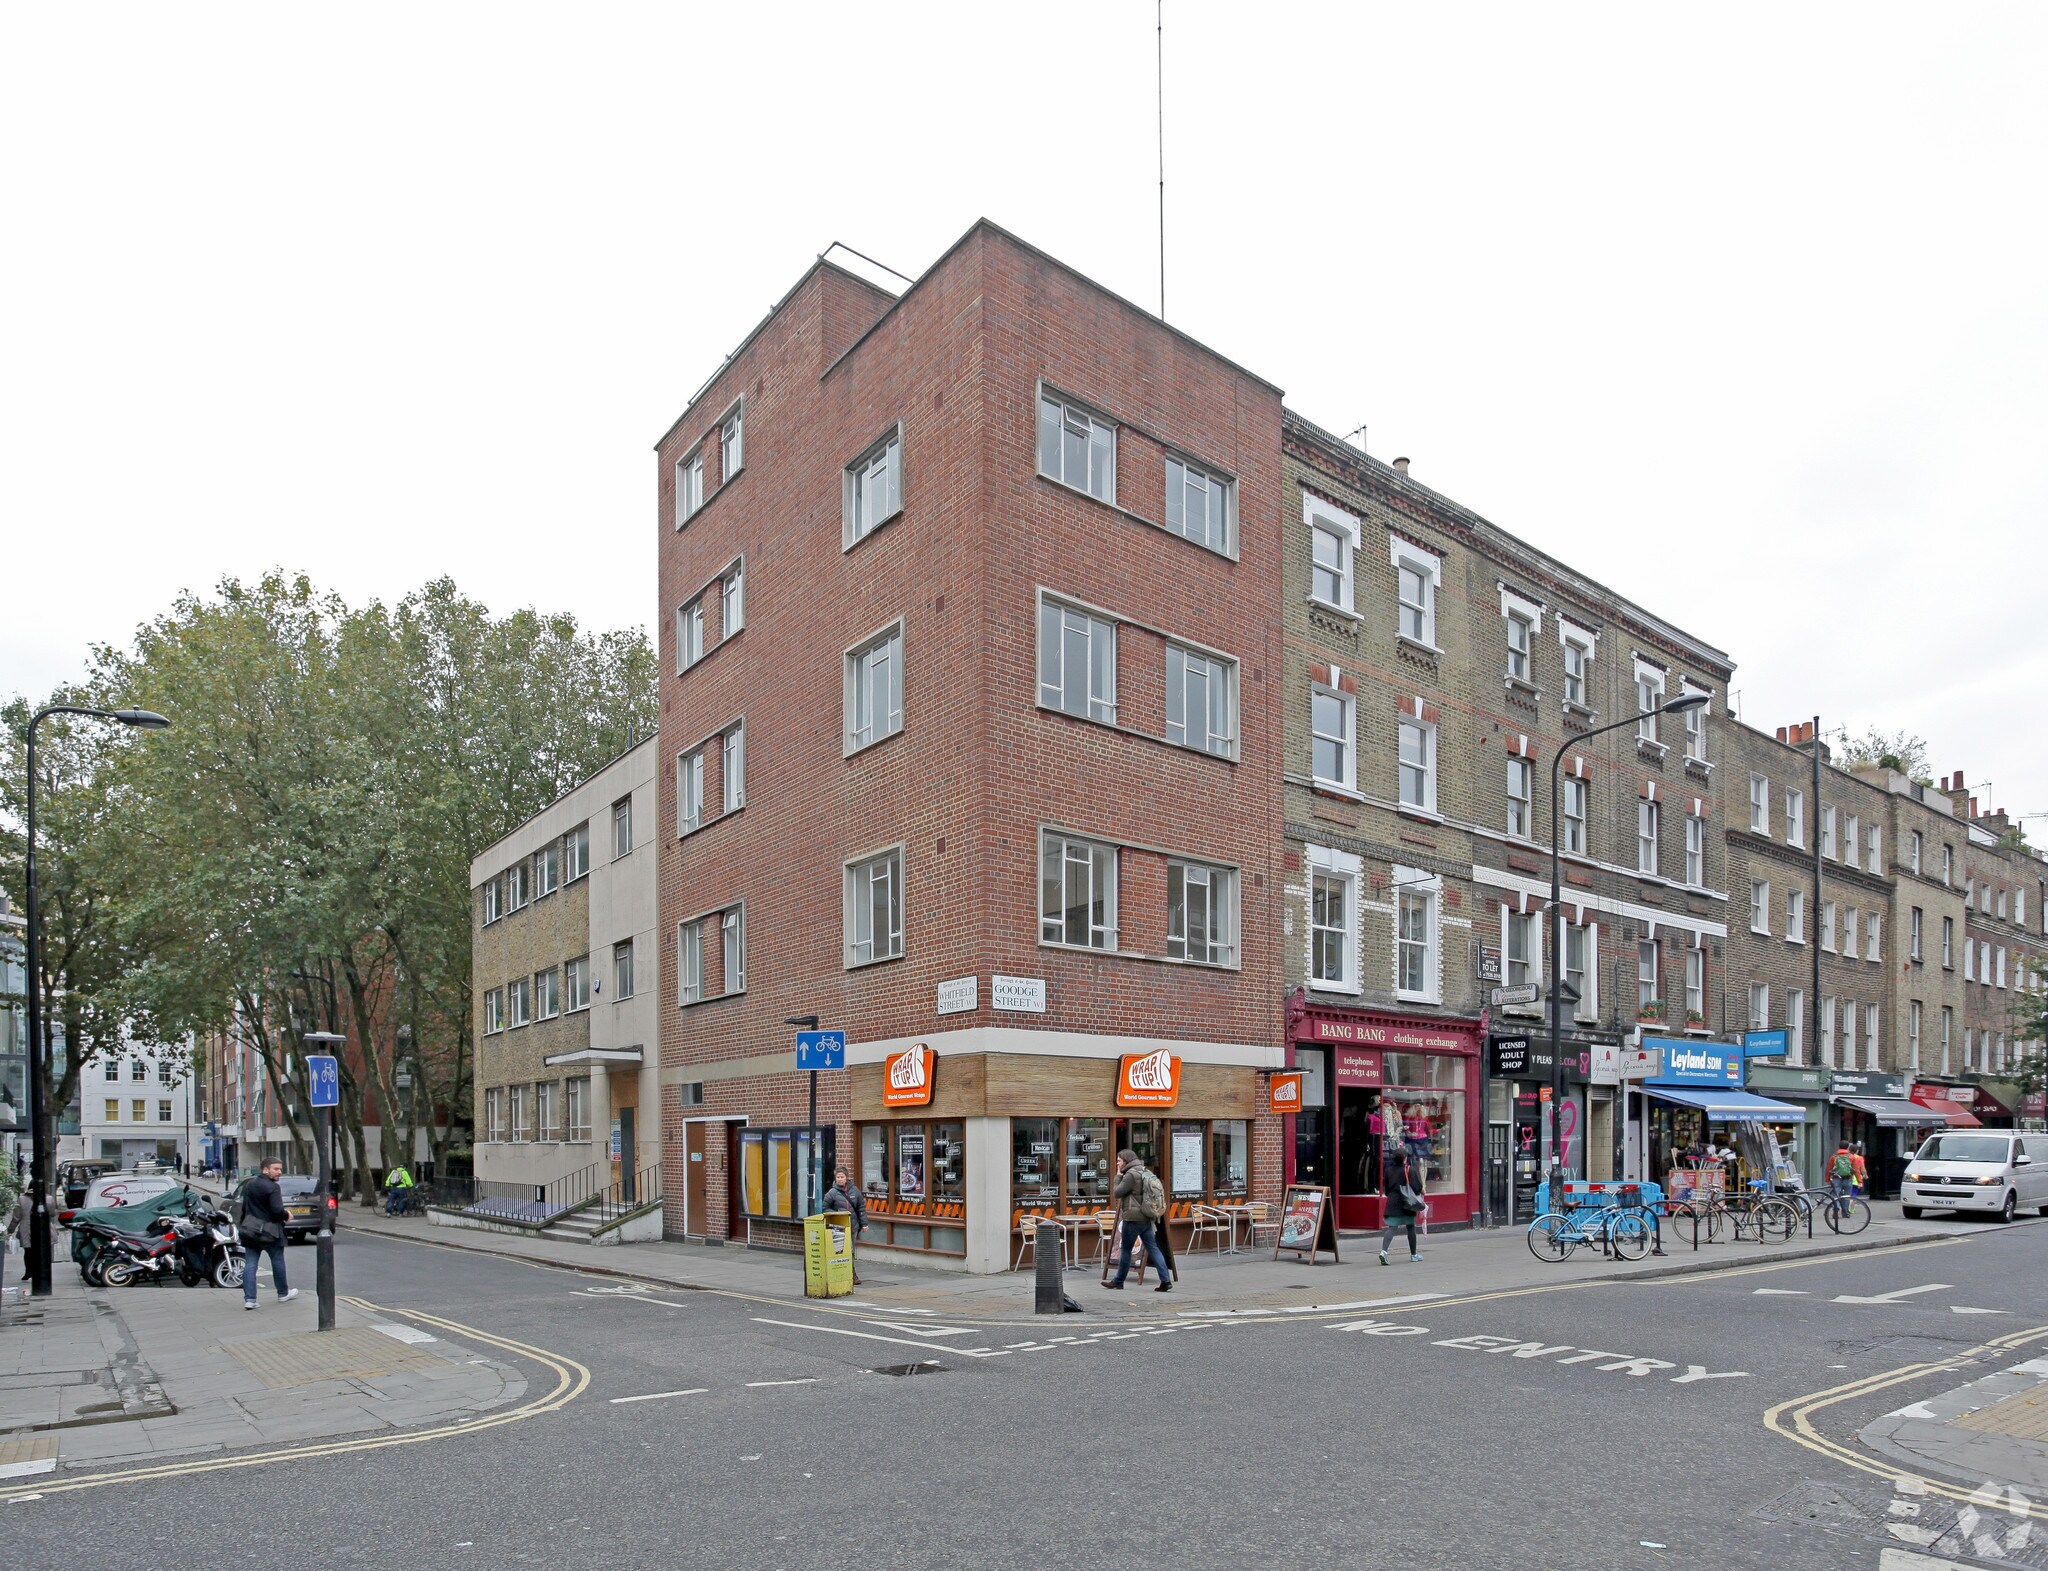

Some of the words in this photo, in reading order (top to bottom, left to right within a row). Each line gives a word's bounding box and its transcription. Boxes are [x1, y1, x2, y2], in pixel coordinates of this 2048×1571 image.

[1490, 964, 1498, 972] LET
[939, 987, 975, 1000] WHITFIELD
[994, 984, 1038, 997] GOODGE
[939, 1000, 965, 1012] STREET
[994, 996, 1032, 1008] STREET
[1321, 1023, 1352, 1039] BANG
[1357, 1027, 1386, 1042] BANG
[1394, 1033, 1424, 1048] clothing
[1426, 1036, 1458, 1050] exchange
[1498, 1041, 1526, 1050] LICENSED
[1344, 1056, 1374, 1066] telephone
[1500, 1052, 1524, 1060] ADULT
[1671, 1048, 1706, 1072] Leyland
[1706, 1056, 1722, 1070] SDM
[893, 1052, 912, 1074] WRAP
[1132, 1056, 1158, 1075] WRAP
[1502, 1061, 1522, 1069] SHOP
[1351, 1068, 1365, 1078] 7631
[1366, 1070, 1379, 1078] 4191
[1132, 1074, 1141, 1086] IT
[1323, 1320, 1430, 1336] NO
[1430, 1334, 1749, 1383] ENTRY
